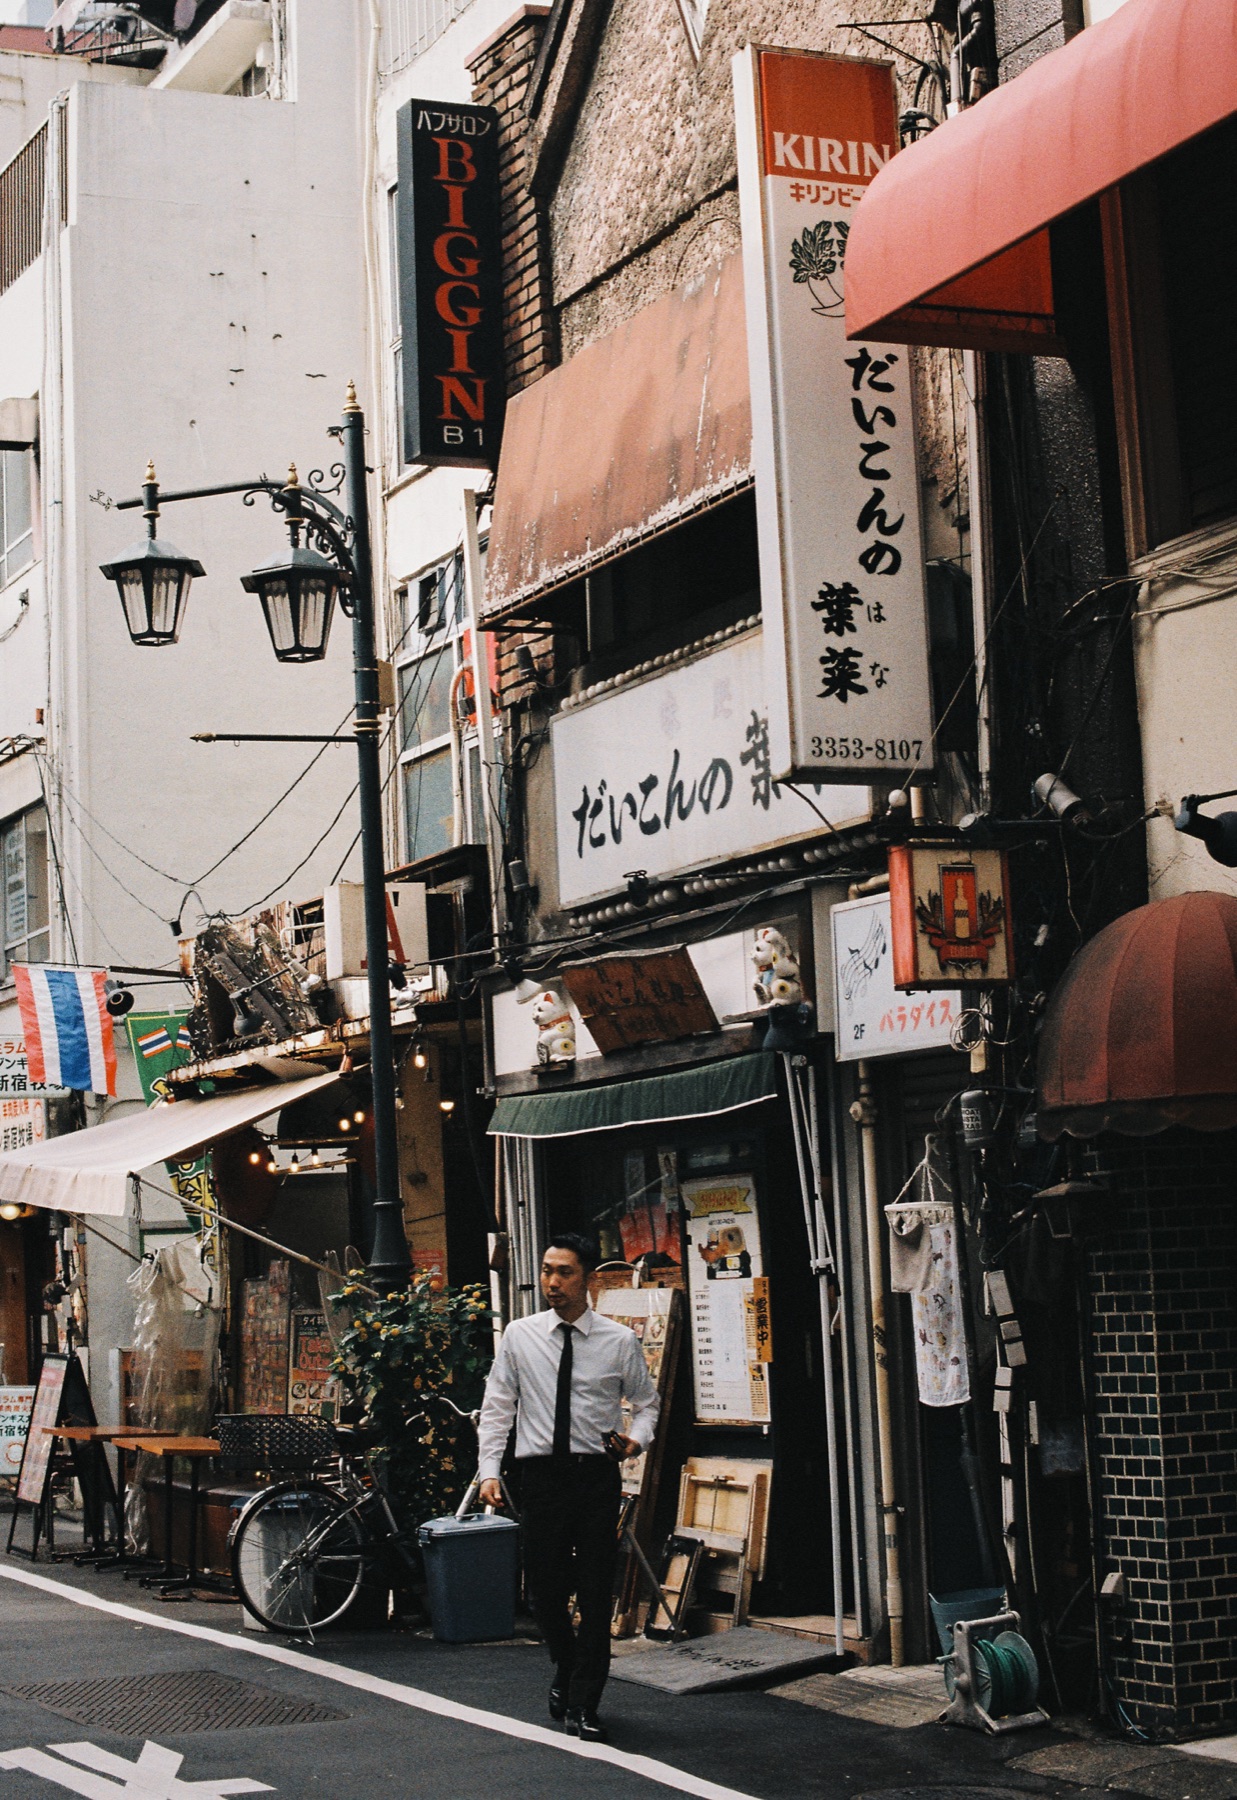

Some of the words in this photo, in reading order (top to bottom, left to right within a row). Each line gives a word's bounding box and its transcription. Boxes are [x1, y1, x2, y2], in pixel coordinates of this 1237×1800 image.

[773, 131, 890, 176] KIRIN
[790, 183, 865, 207] キリンビー
[431, 137, 488, 421] BIGGIN
[844, 347, 904, 575] だいこんの
[811, 581, 868, 703] 葉菜
[811, 736, 923, 770] 3353-8107
[572, 709, 821, 859] だいこんの葉
[853, 1024, 866, 1040] 2F
[879, 999, 954, 1033] パラダイス
[299, 1336, 331, 1353] Take
